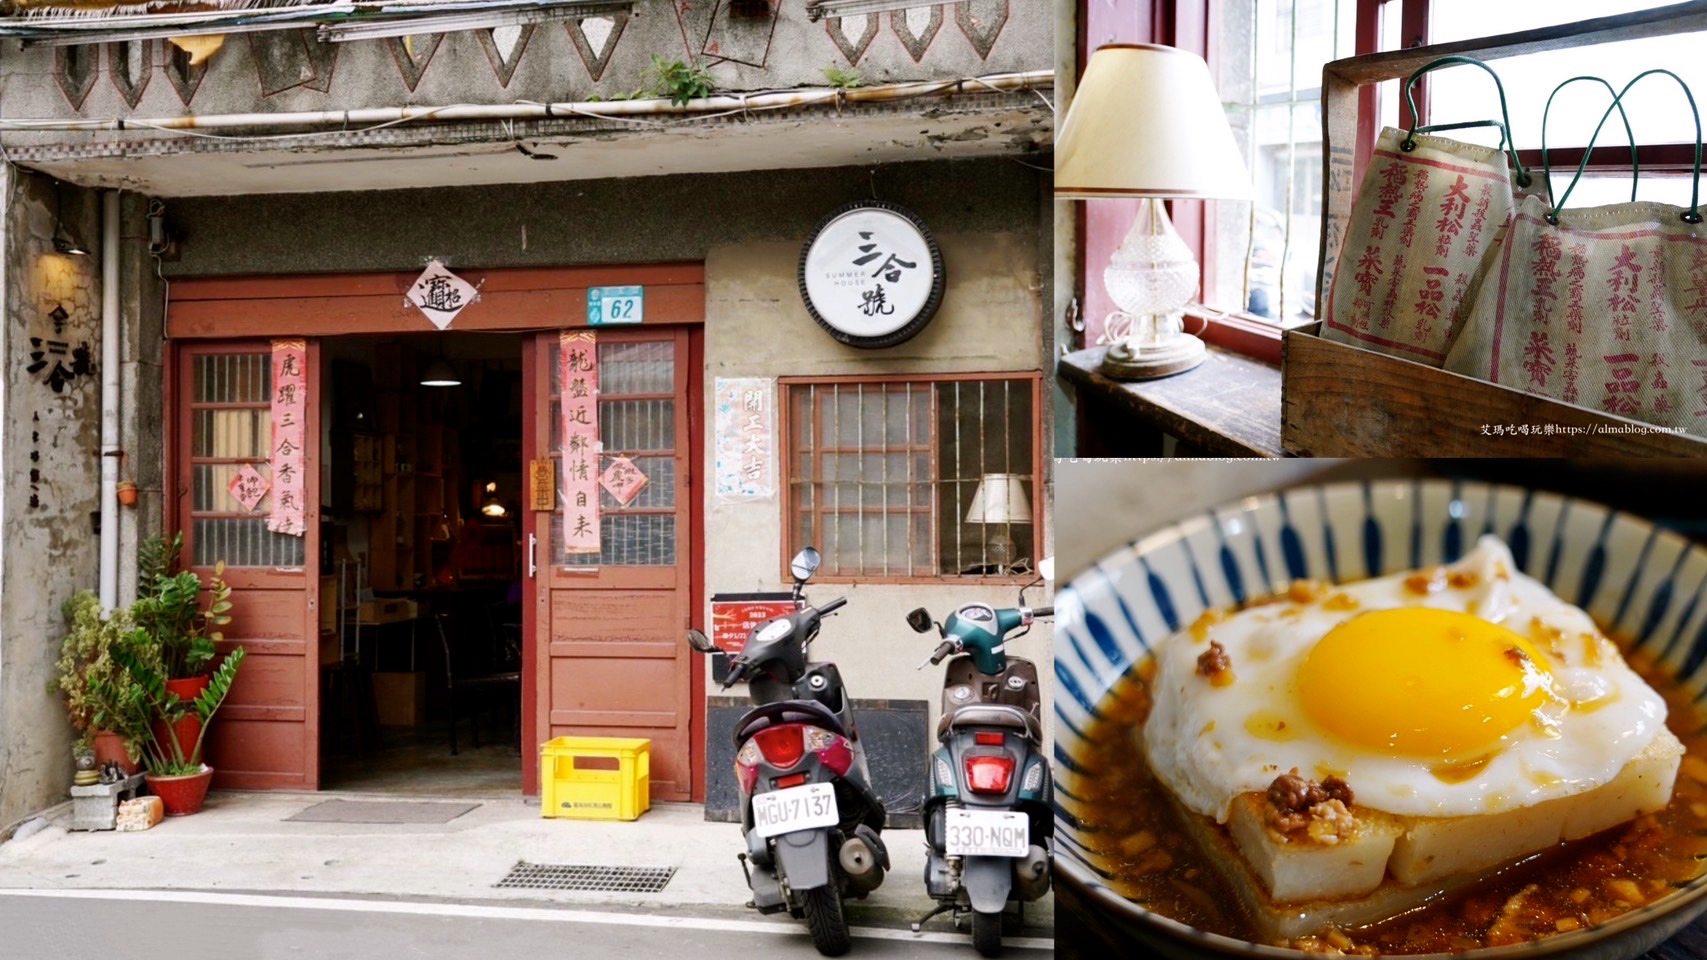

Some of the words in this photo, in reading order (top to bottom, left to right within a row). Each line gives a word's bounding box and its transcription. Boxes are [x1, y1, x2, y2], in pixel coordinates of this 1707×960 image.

[1435, 174, 1471, 237] 大利松
[825, 270, 866, 279] SUMMER
[834, 279, 866, 287] HOUSE
[1414, 266, 1450, 320] 一品松
[1606, 244, 1643, 313] 大利松
[610, 299, 634, 319] 62
[1602, 353, 1642, 415] 一品松
[743, 389, 765, 480] 開工大吉
